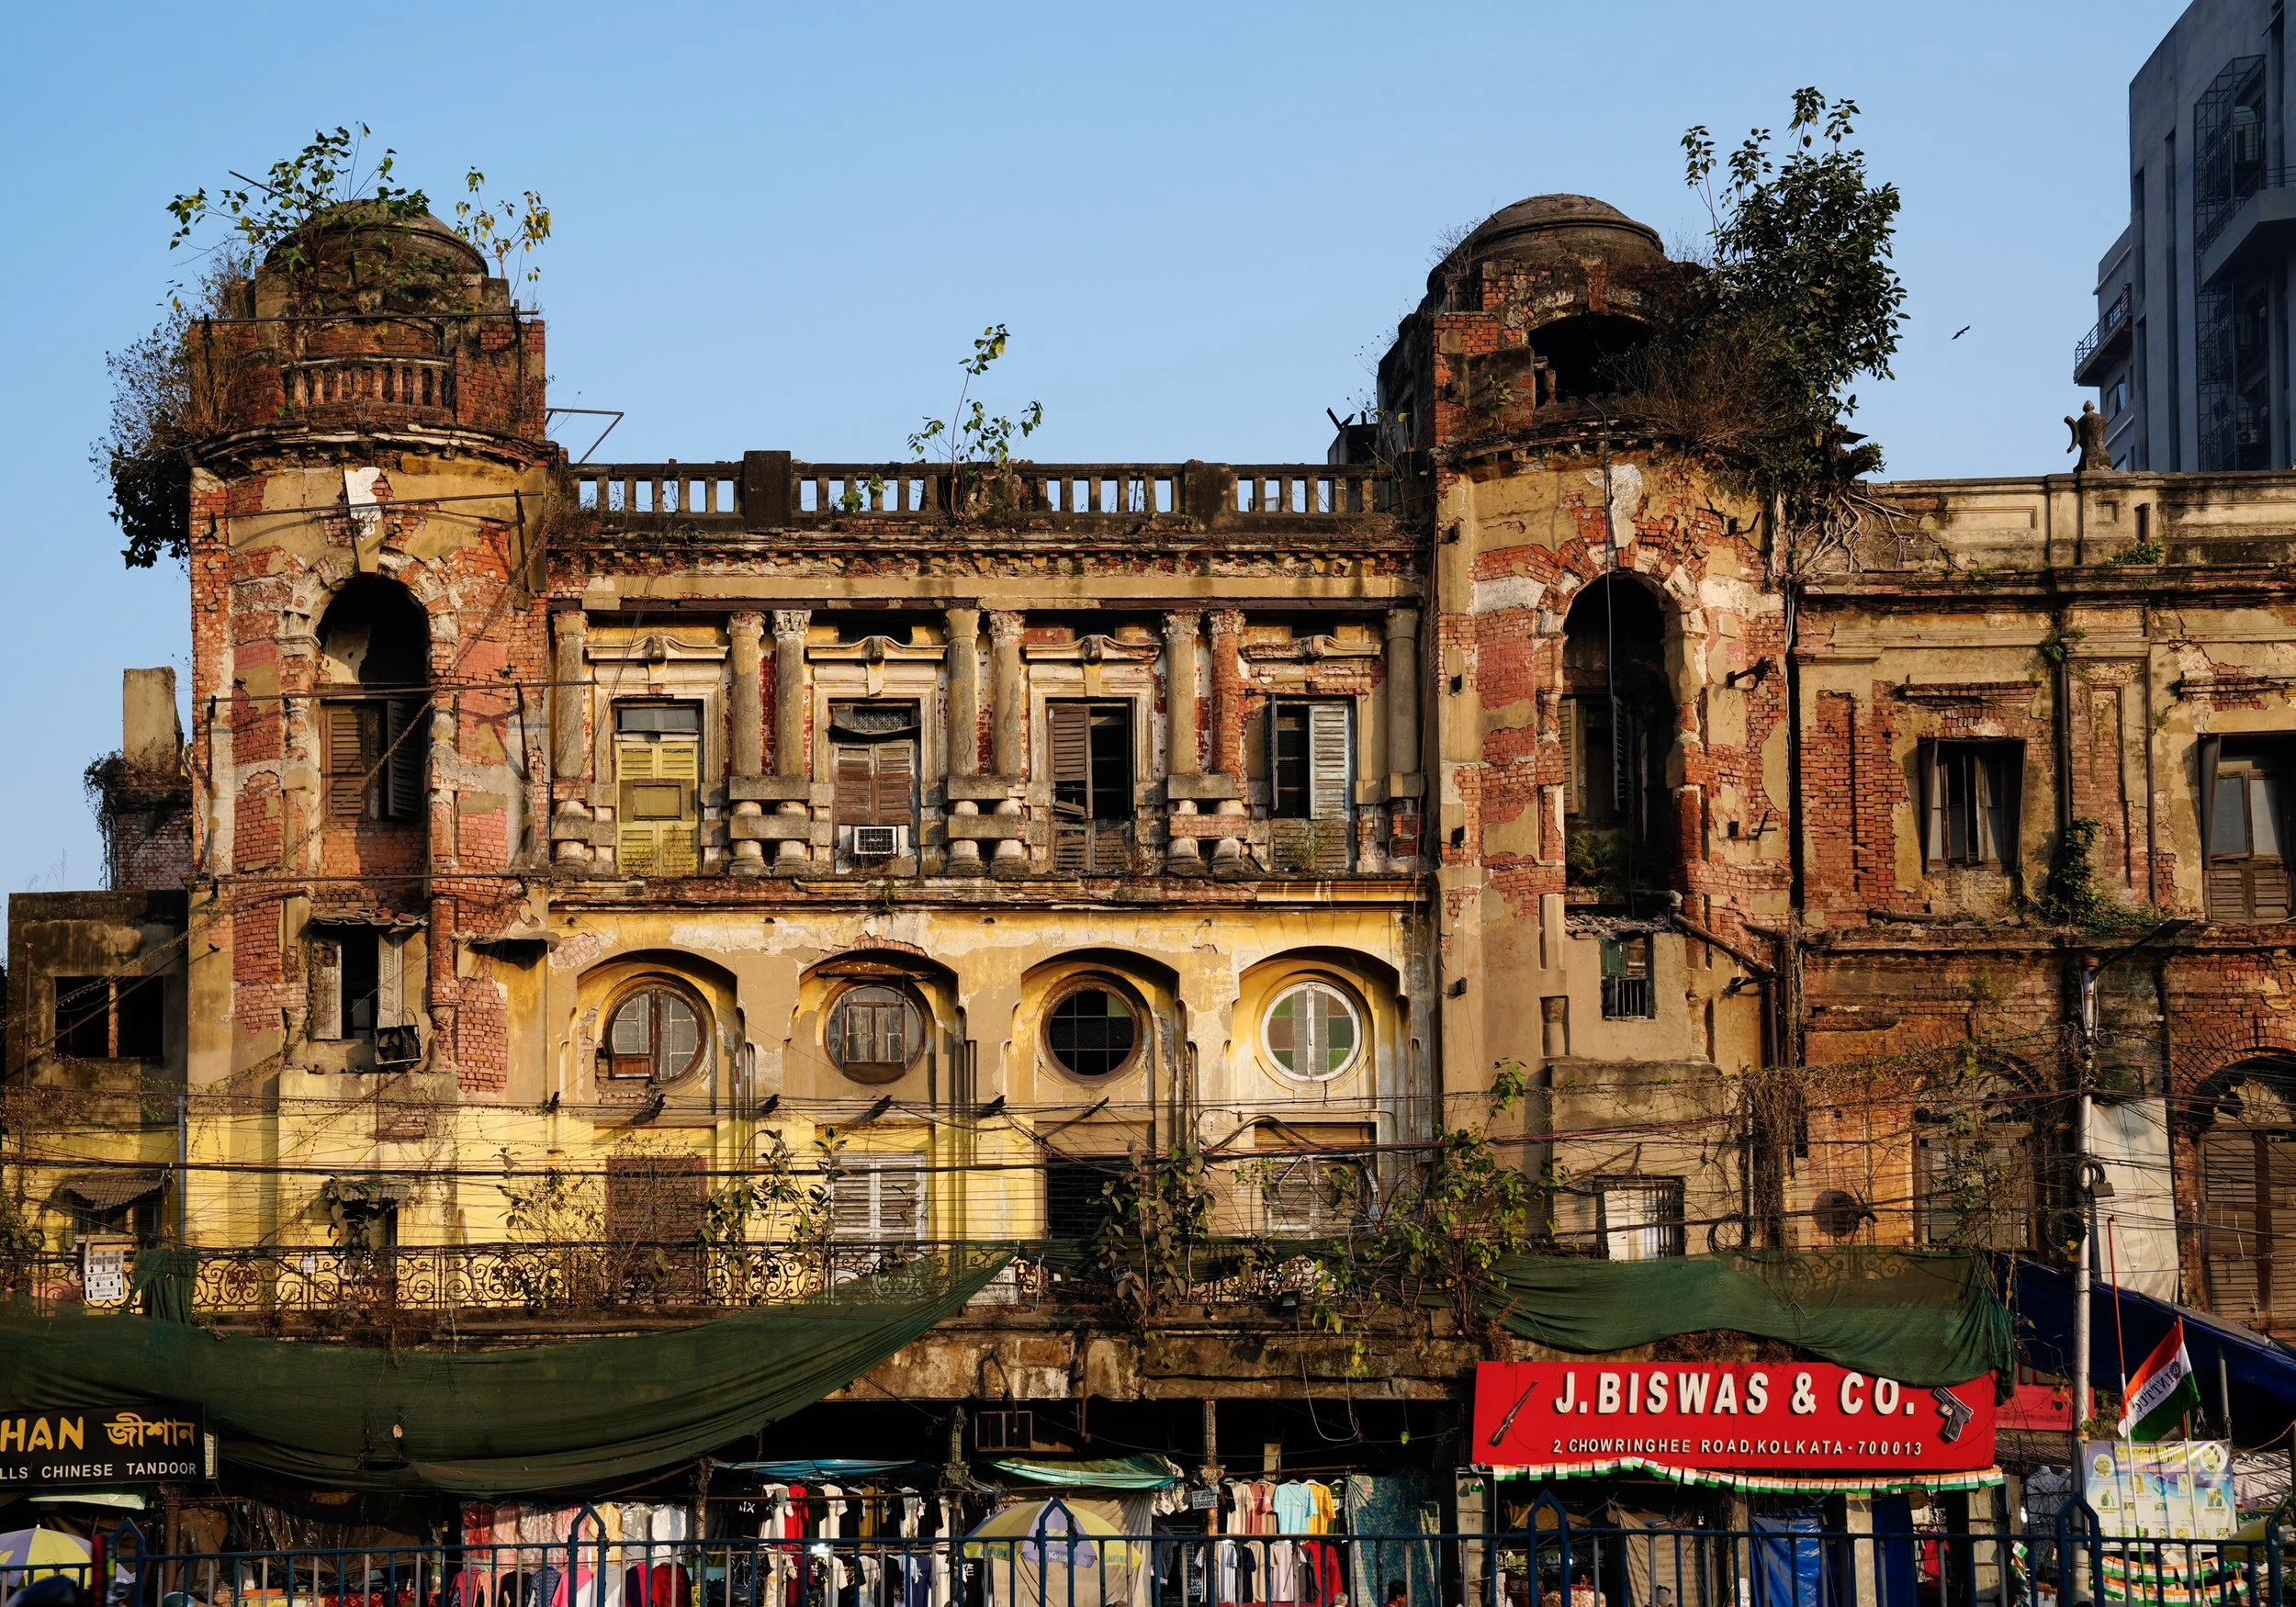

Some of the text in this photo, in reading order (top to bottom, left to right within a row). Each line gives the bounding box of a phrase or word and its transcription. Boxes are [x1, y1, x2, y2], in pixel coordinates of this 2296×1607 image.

[89, 1256, 120, 1265] xerox
[1556, 1371, 1915, 1415] J.BISWAS & CO.
[0, 1416, 84, 1452] HAN
[103, 1411, 196, 1448] জীশান
[1569, 1438, 1691, 1454] CHOWRINGHEE
[41, 1464, 113, 1478] CHINESE
[126, 1462, 197, 1475] TANDOOR
